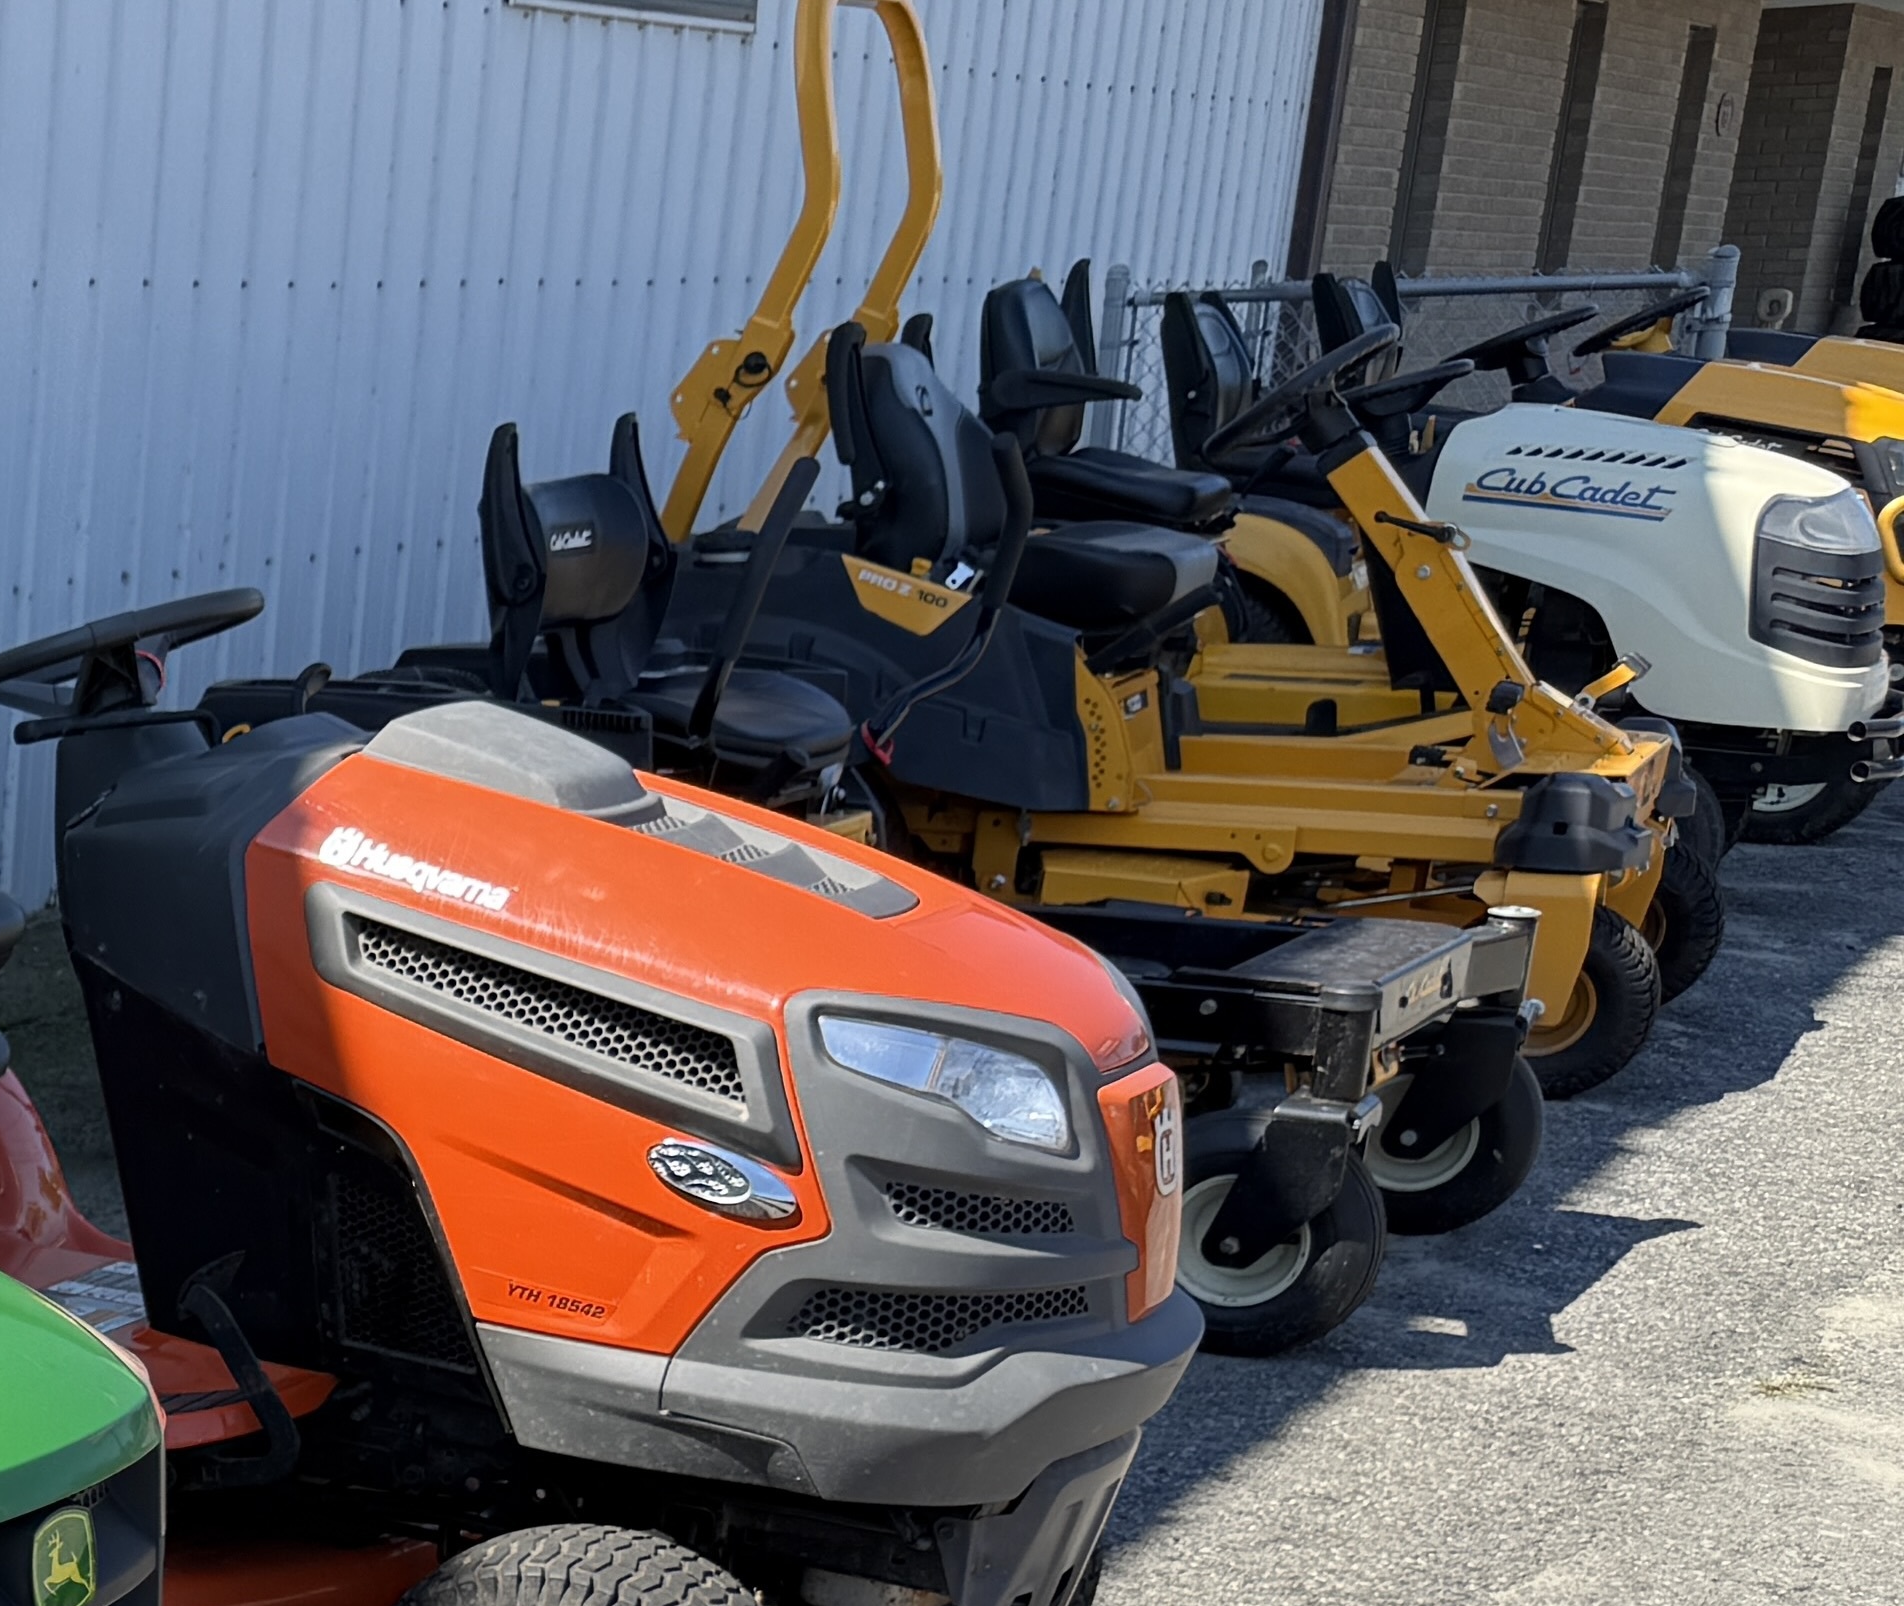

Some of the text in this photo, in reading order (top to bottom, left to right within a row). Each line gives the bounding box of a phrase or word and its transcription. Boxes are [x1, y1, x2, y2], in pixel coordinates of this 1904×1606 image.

[1477, 468, 1676, 510] Cub Cadet
[859, 569, 948, 608] PRO Z 100
[350, 838, 510, 911] Husqvarna
[508, 1283, 606, 1319] YTH 18542
